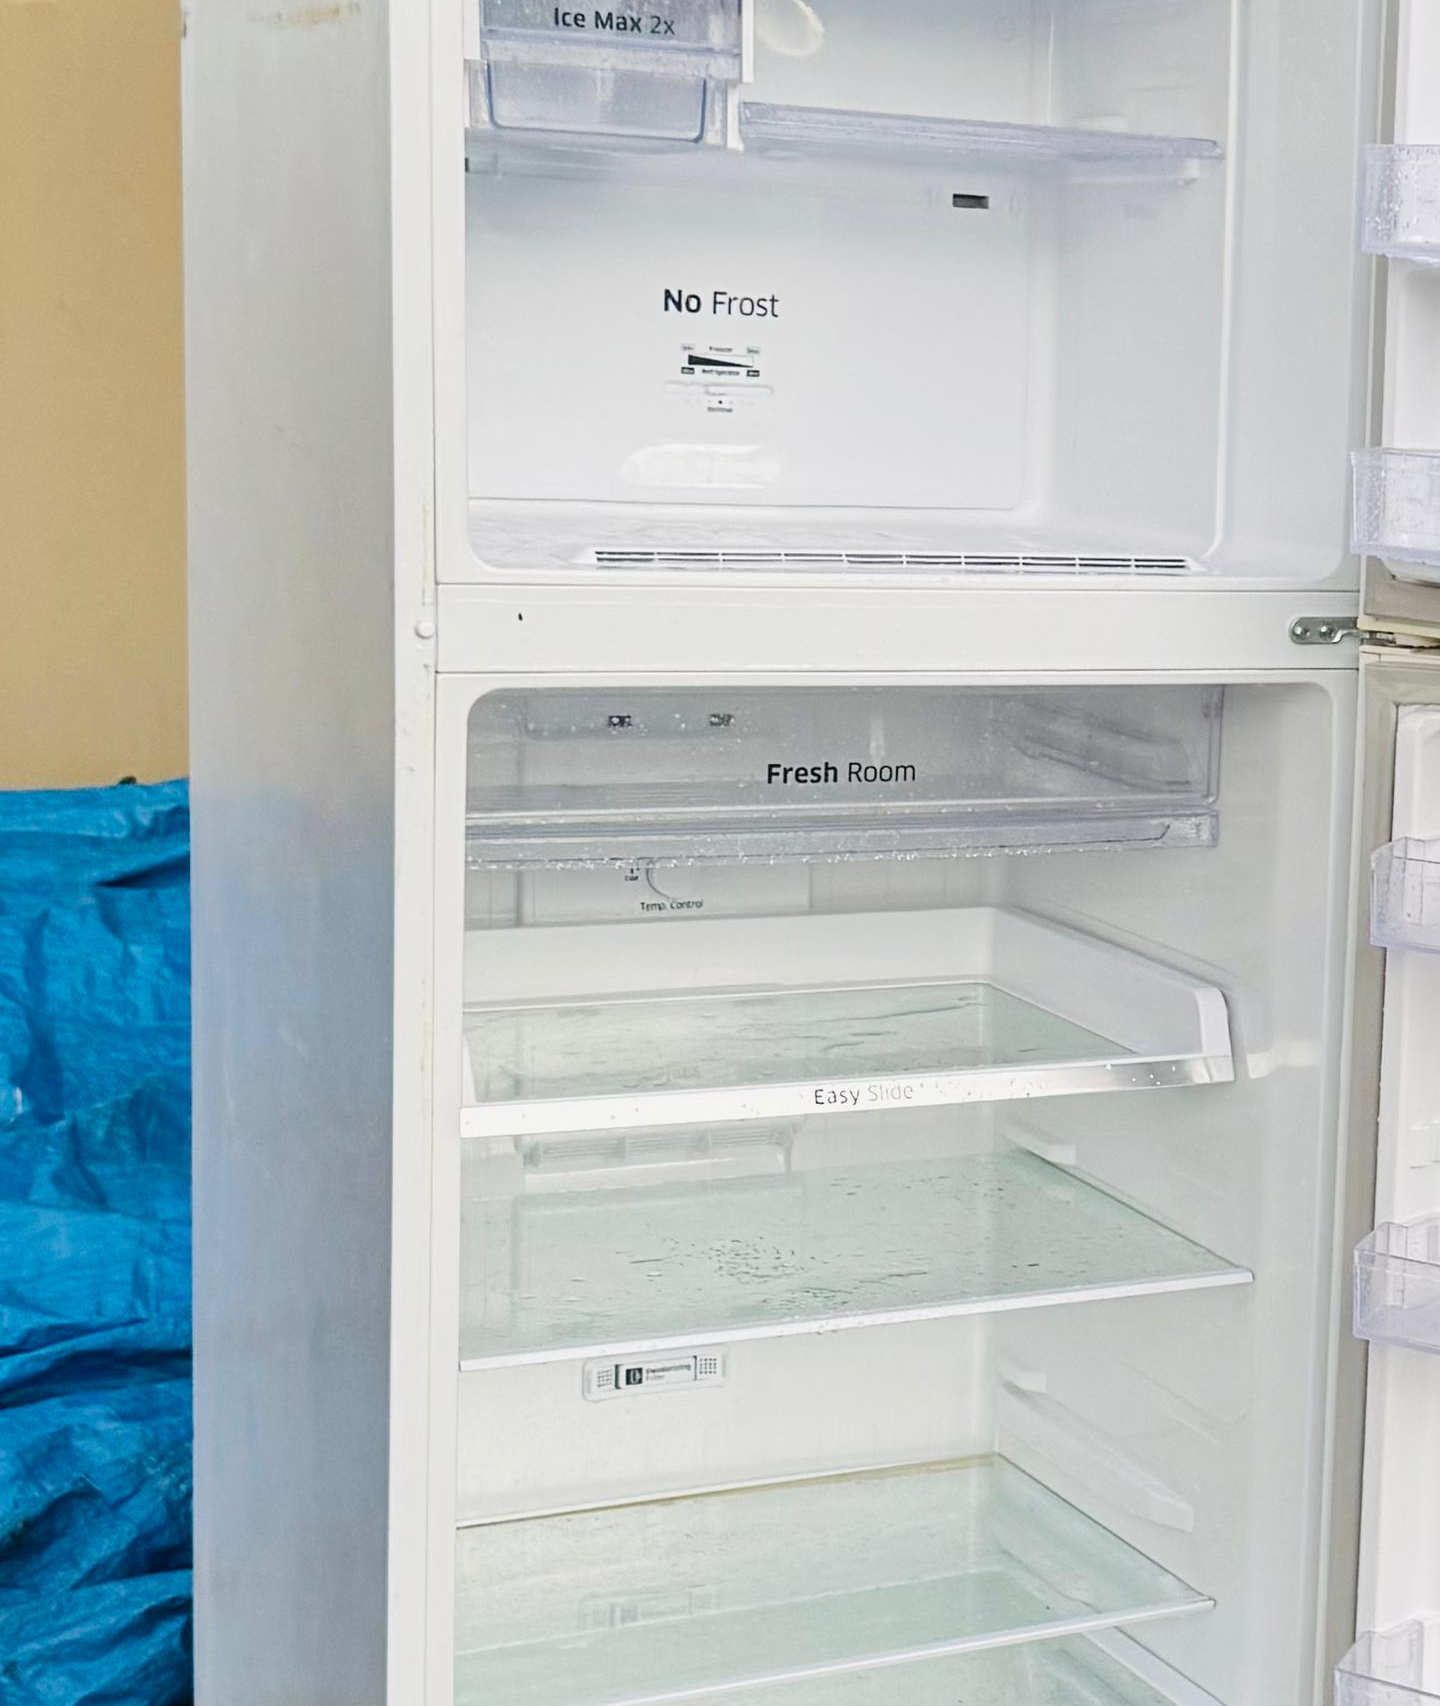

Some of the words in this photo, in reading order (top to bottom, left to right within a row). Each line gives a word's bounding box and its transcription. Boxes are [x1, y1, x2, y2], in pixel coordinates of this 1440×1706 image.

[553, 6, 586, 29] Ice
[594, 10, 642, 34] Max
[649, 14, 676, 36] 2x
[663, 288, 702, 313] No
[712, 290, 779, 318] Frost
[766, 761, 839, 785] Fresh
[847, 761, 916, 783] Room
[813, 1088, 860, 1106] Easy
[867, 1084, 914, 1102] Slide
